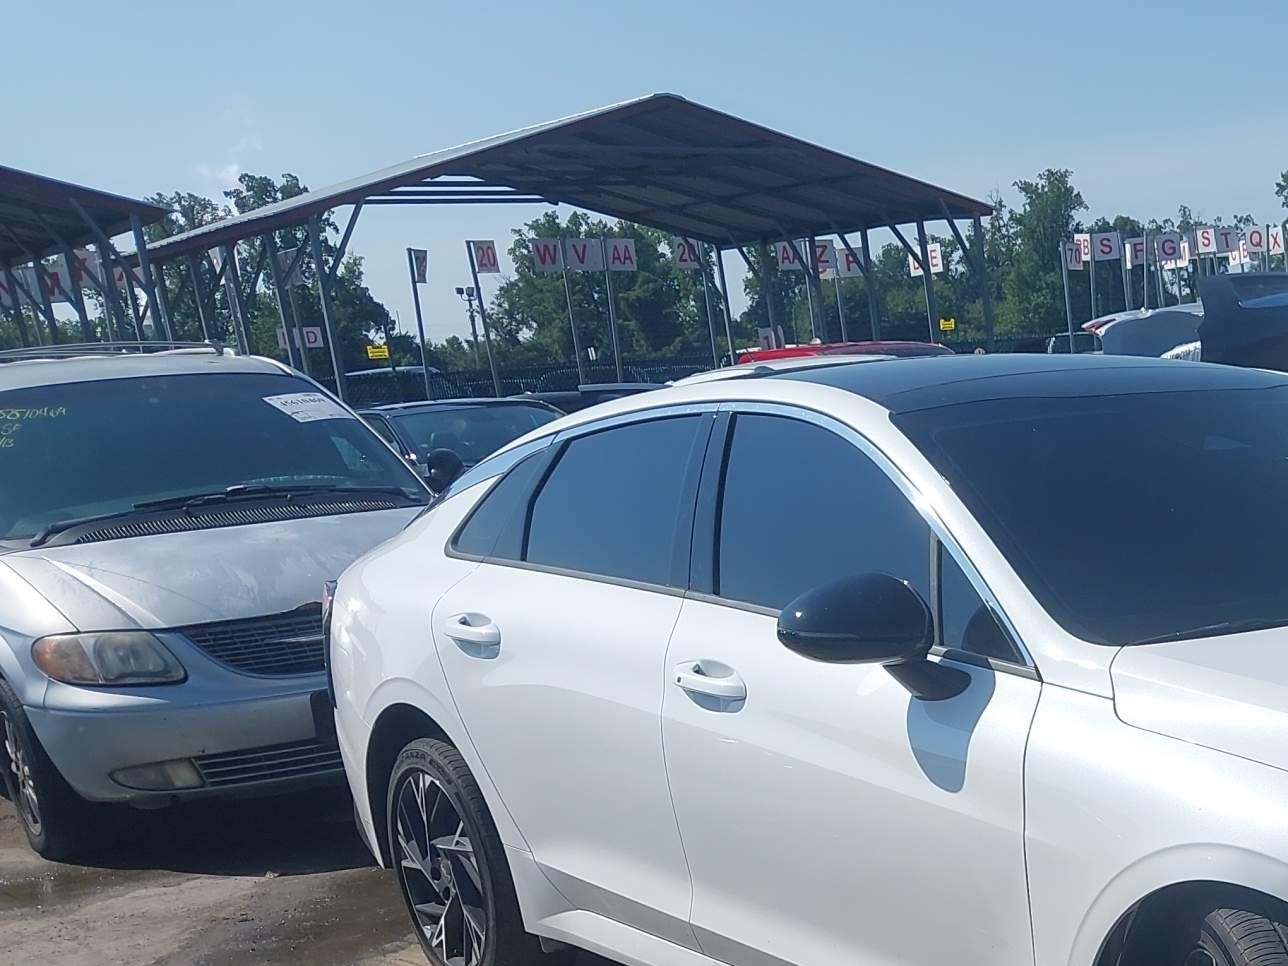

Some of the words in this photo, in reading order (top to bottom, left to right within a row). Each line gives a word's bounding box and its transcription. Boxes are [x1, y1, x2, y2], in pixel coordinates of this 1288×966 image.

[1100, 238, 1113, 254] S
[1162, 239, 1176, 256] G
[1202, 231, 1211, 247] S
[1221, 232, 1231, 248] T
[1250, 231, 1262, 247] Q
[1271, 232, 1281, 249] X
[477, 246, 496, 267] 20
[535, 244, 557, 264] W
[572, 244, 587, 264] V
[612, 245, 634, 265] AA
[816, 245, 829, 263] Z
[929, 249, 939, 267] E
[1067, 248, 1081, 264] 70
[1134, 243, 1143, 259] F
[307, 331, 318, 344] D
